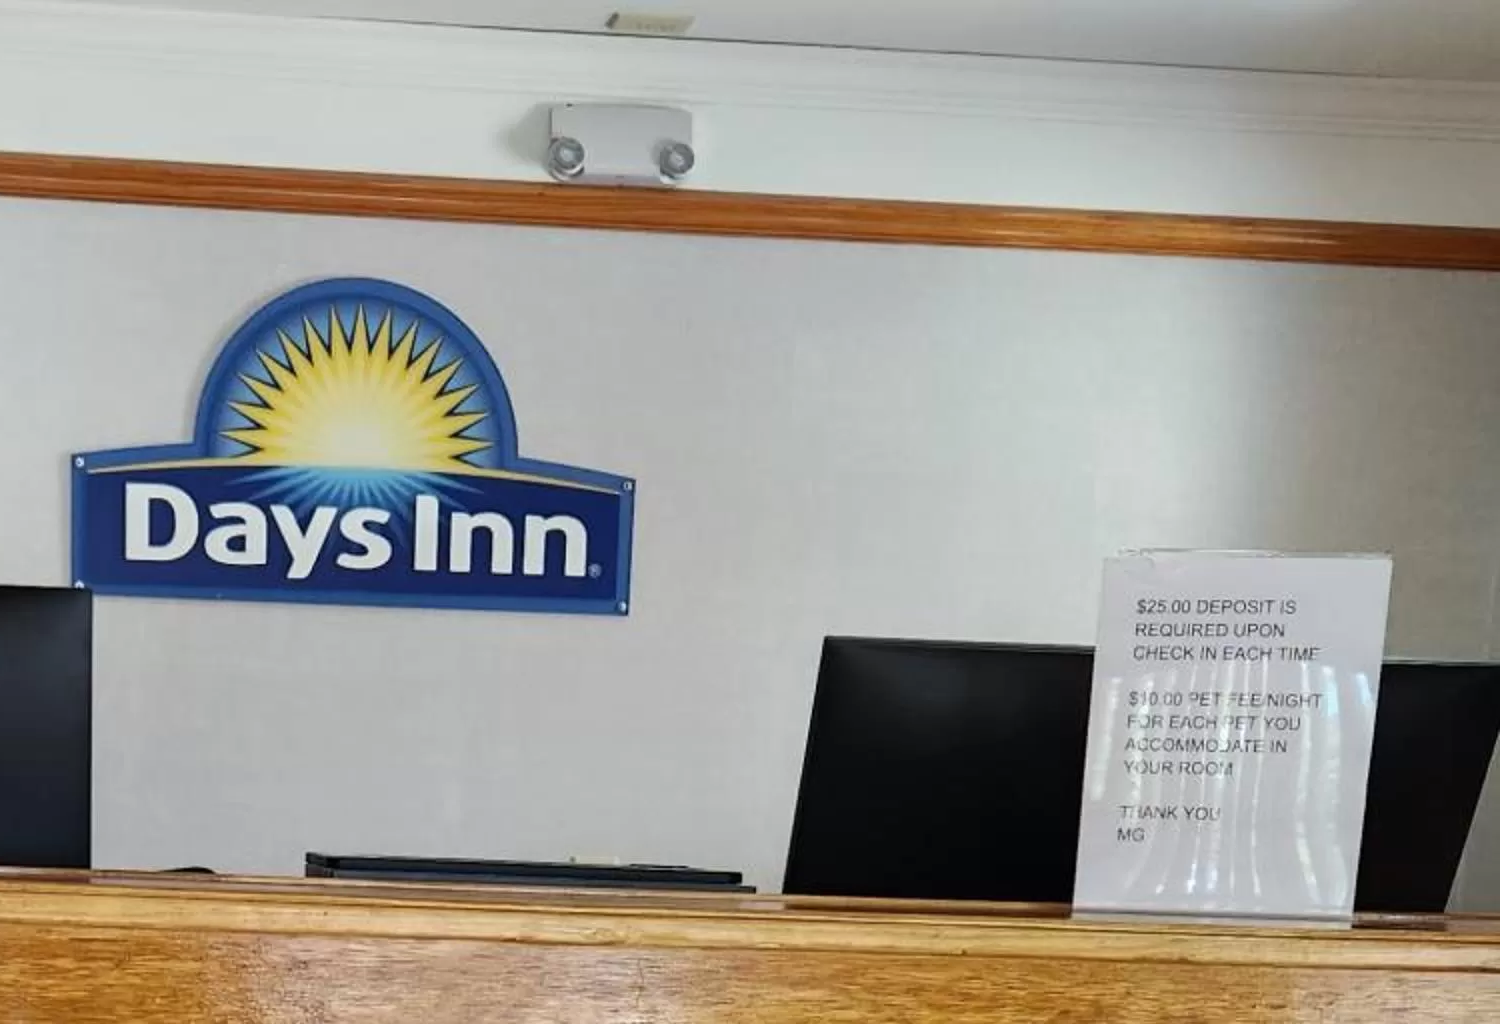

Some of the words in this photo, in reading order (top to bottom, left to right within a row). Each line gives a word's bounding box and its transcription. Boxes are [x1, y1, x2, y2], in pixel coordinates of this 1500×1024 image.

[125, 481, 392, 579] Days
[414, 494, 588, 578] Inn
[1136, 599, 1191, 615] $25.00
[1196, 600, 1275, 615] DEPOSIT
[1280, 600, 1297, 615] IS
[1135, 623, 1229, 638] REQUIRED
[1233, 623, 1285, 638] UPON
[1133, 646, 1195, 661] CHECK
[1200, 646, 1217, 661] IN
[1223, 646, 1272, 662] EACH
[1277, 647, 1321, 662] TIME
[1187, 691, 1220, 707] PET
[1126, 715, 1164, 730] FOR
[1169, 715, 1217, 730] EACH
[1224, 715, 1258, 731] PET
[1263, 716, 1301, 731] YOU
[1124, 738, 1265, 753] ACCOMMODATE
[1270, 739, 1288, 753] IN
[1124, 761, 1173, 776] YOUR
[1179, 761, 1233, 776] ROOM
[1116, 805, 1178, 820] THANK
[1183, 806, 1221, 821] YOU
[1116, 827, 1145, 842] MG
